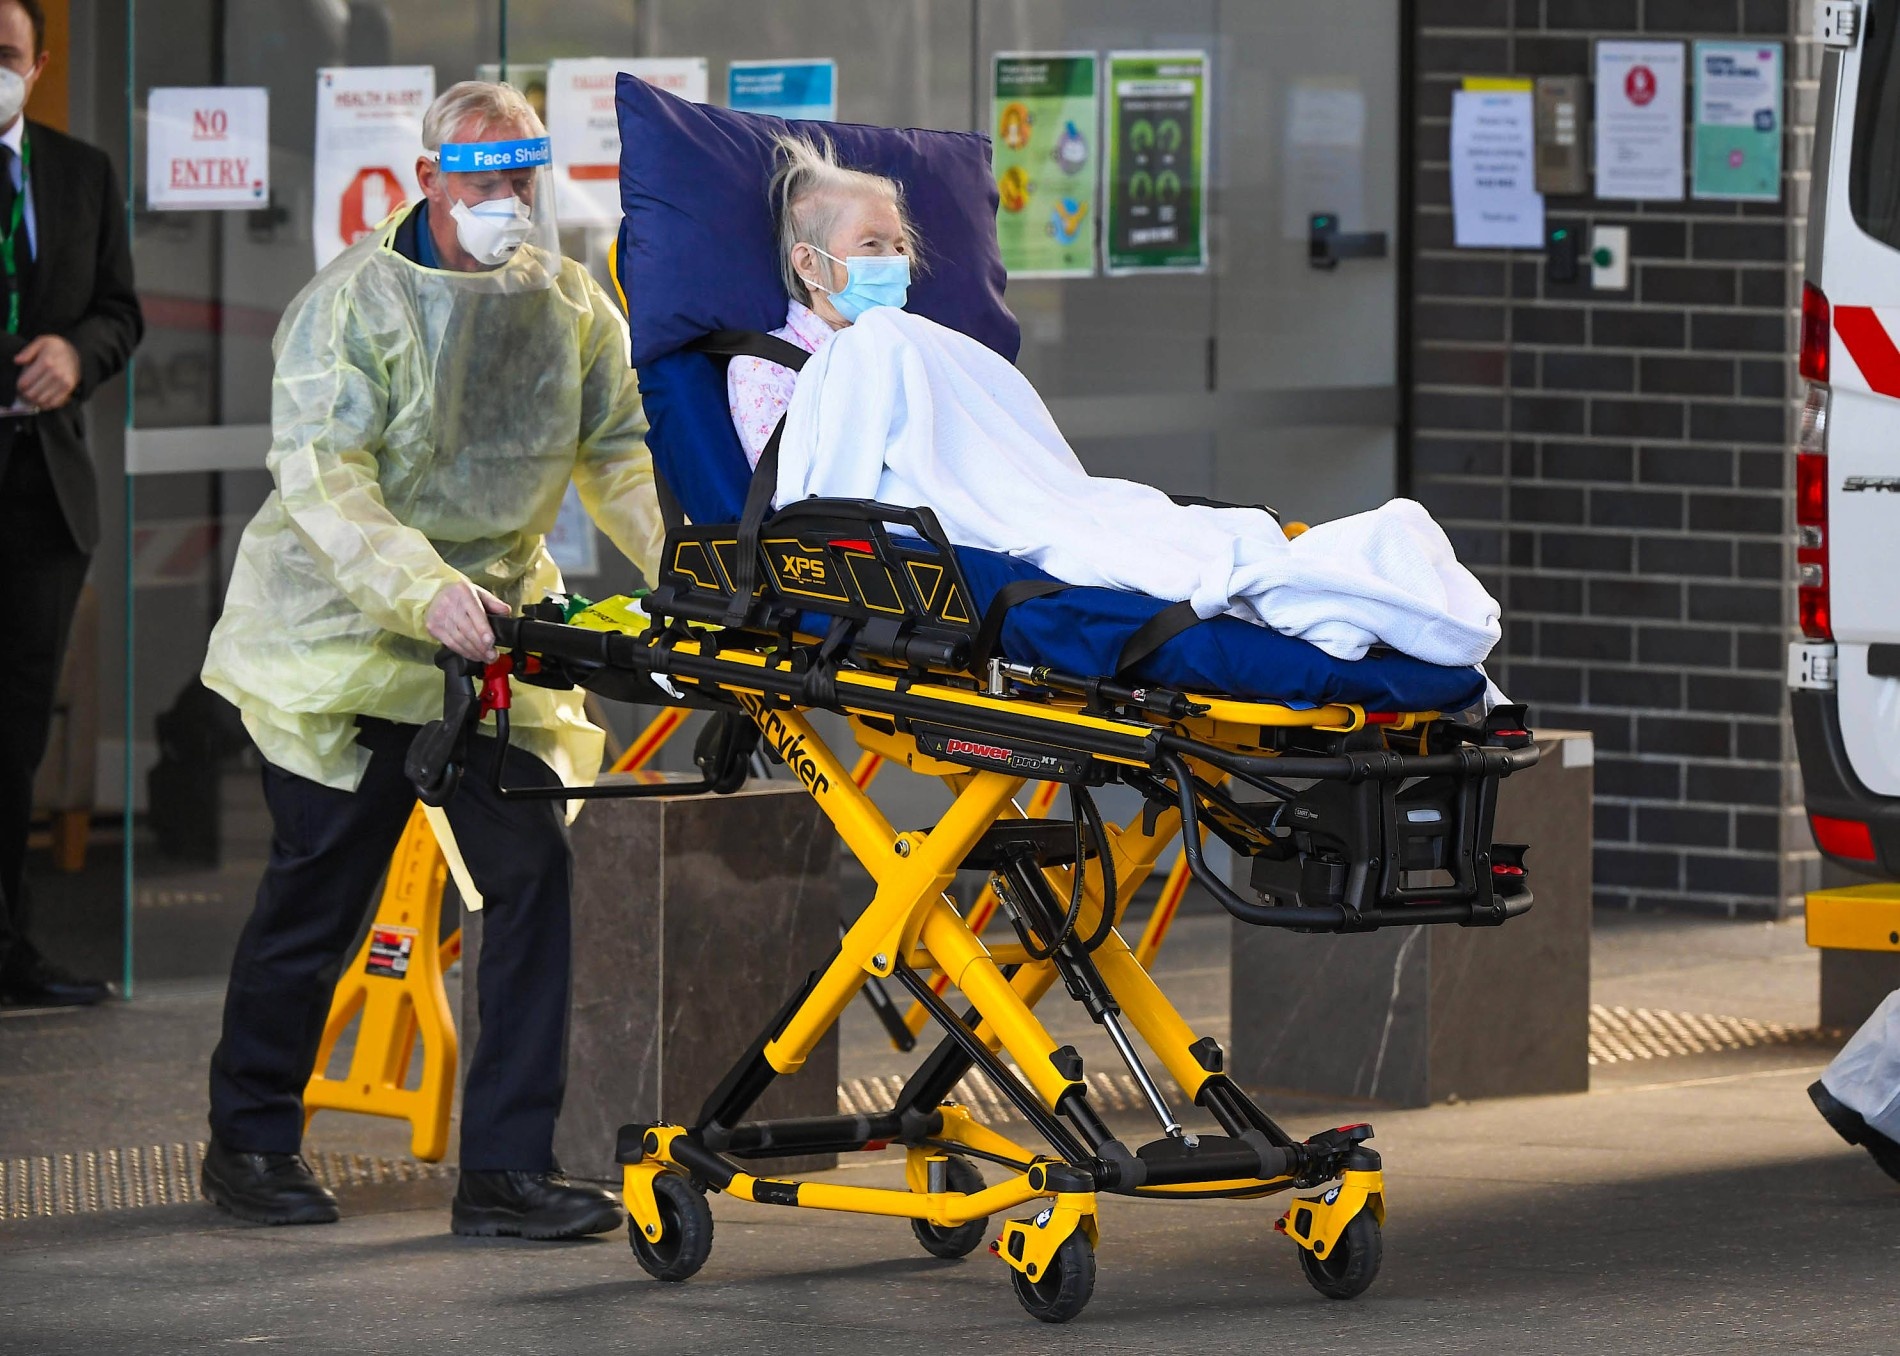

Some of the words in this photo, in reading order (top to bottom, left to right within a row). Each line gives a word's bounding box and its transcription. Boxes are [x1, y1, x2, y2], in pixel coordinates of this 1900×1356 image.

[194, 109, 228, 136] NO
[474, 151, 511, 166] Face
[515, 145, 548, 163] Shield
[171, 158, 249, 187] ENTRY
[782, 554, 825, 579] XPS
[946, 738, 1012, 760] power
